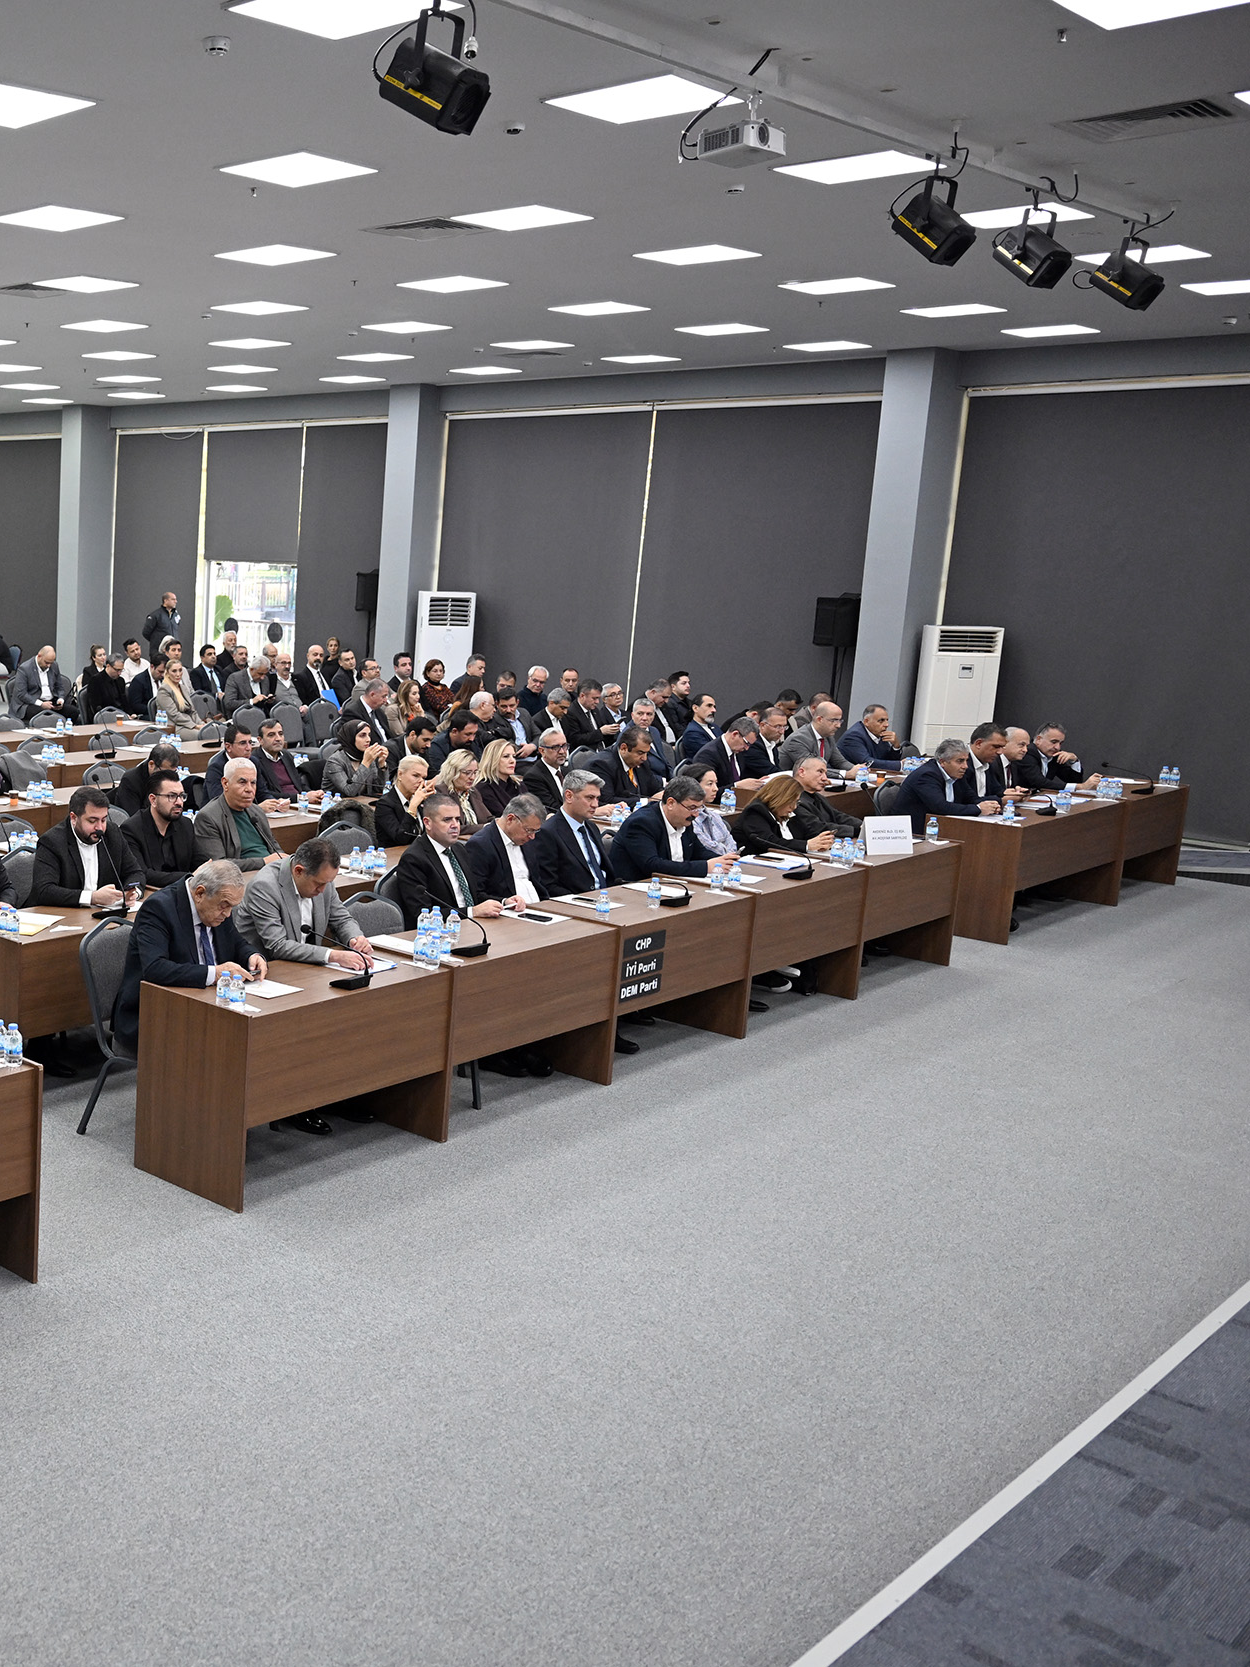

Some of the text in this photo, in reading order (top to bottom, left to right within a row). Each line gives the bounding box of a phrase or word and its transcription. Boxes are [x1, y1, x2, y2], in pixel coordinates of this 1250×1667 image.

[635, 936, 652, 951] CHP
[626, 958, 657, 978] İYİ Parti
[620, 978, 658, 999] DEM Parti
